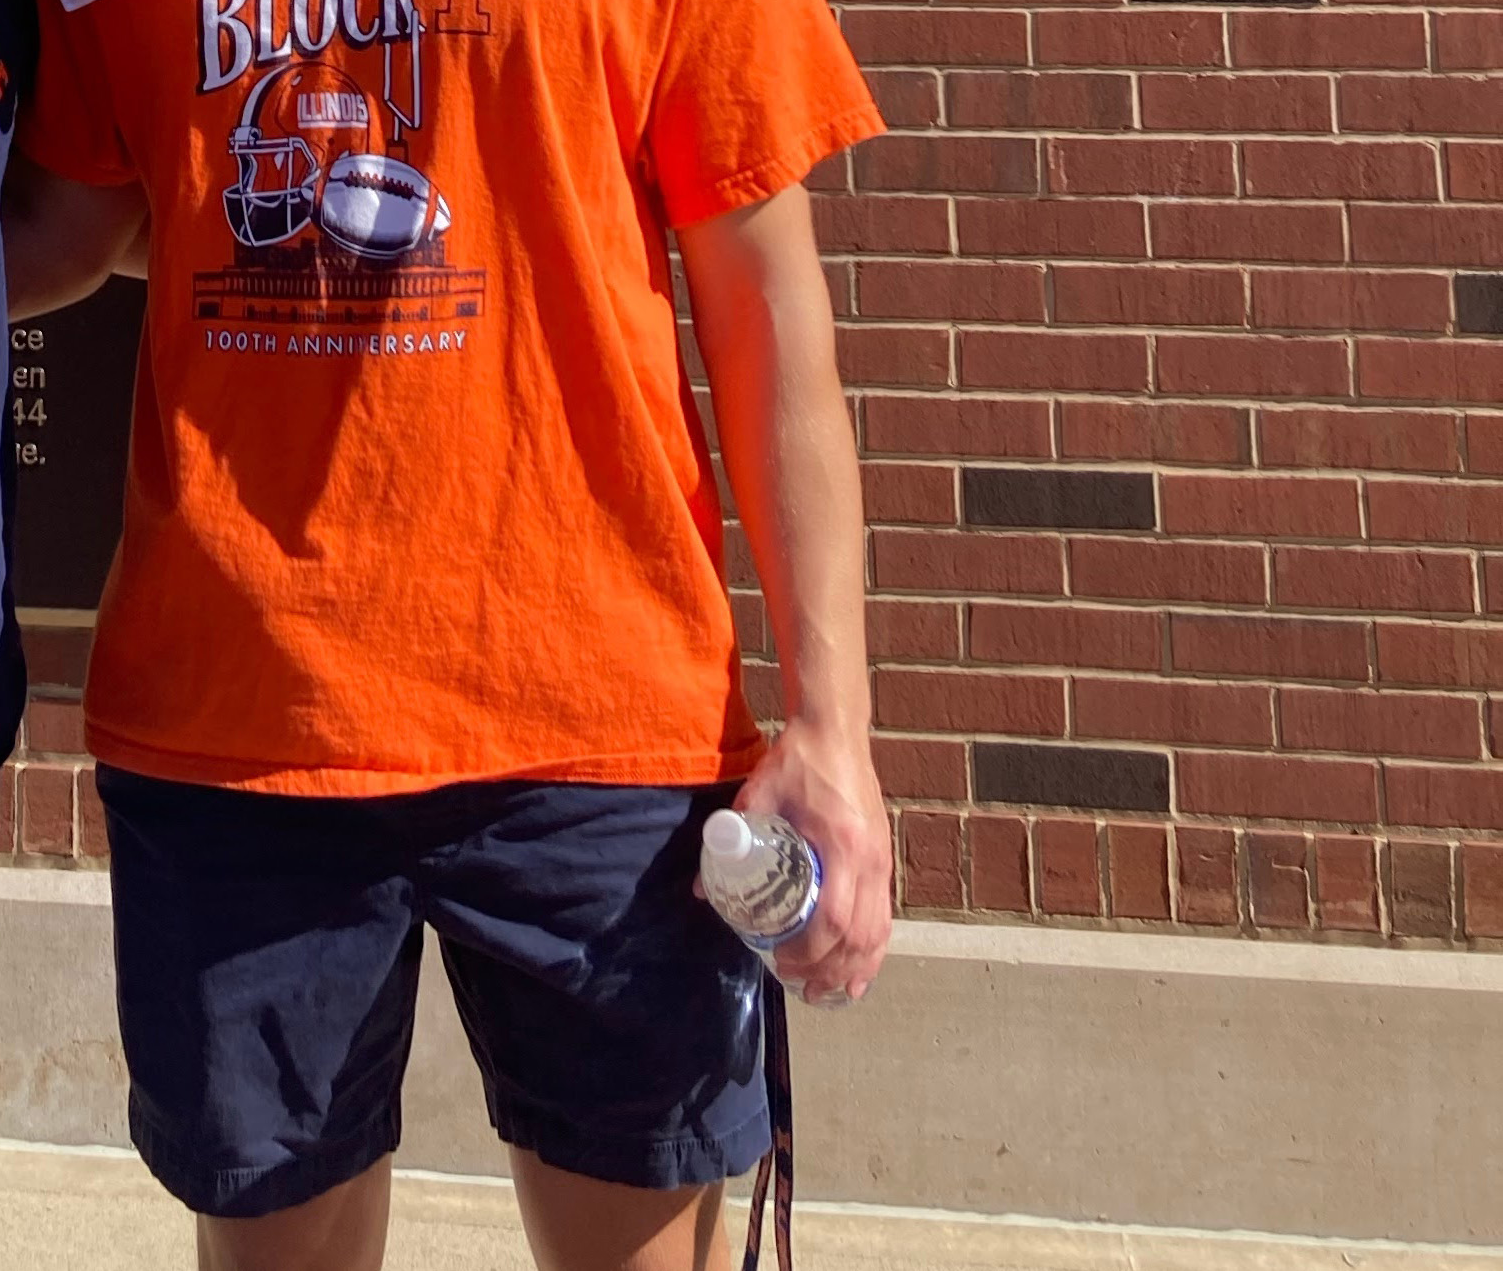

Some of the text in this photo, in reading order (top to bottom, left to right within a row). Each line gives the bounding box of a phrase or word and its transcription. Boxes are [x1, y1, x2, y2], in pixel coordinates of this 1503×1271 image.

[297, 92, 369, 122] ILLINOIS
[205, 329, 467, 356] 100TH ANNIVERSARY
